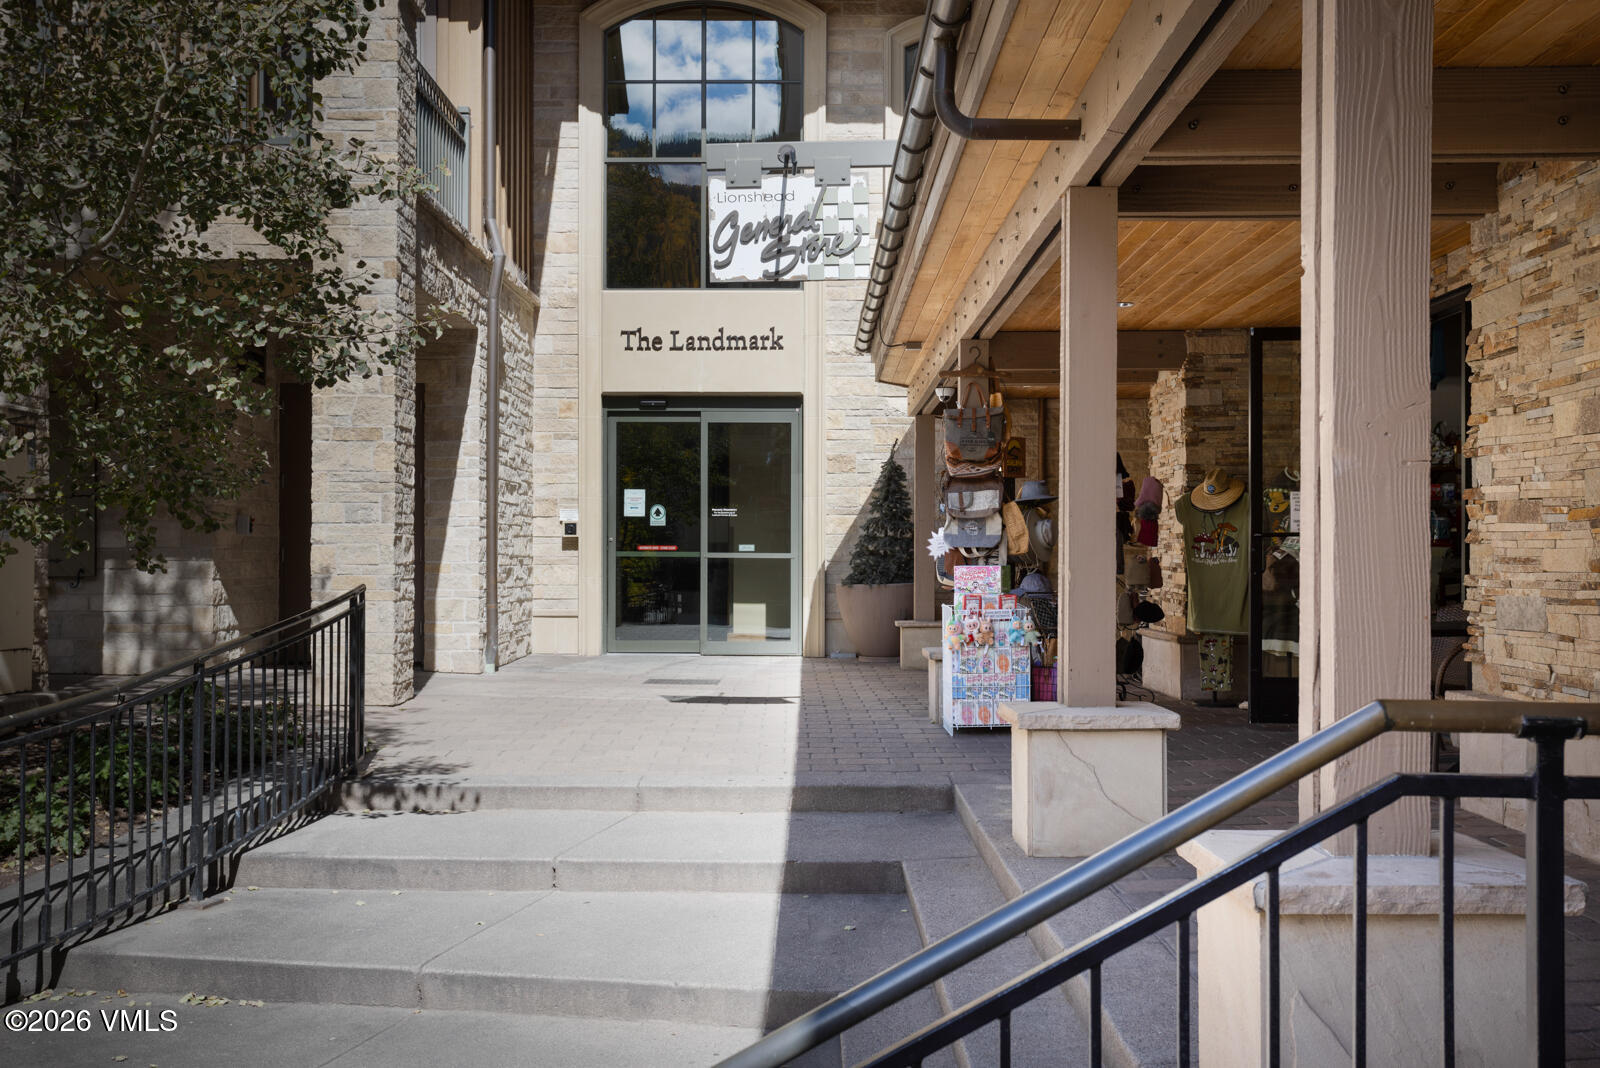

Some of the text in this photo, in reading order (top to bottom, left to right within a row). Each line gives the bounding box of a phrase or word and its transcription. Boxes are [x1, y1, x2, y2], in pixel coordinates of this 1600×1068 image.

[716, 190, 795, 204] Lionshead
[712, 183, 827, 270] General
[760, 224, 863, 280] Store
[620, 327, 784, 352] The Landmark
